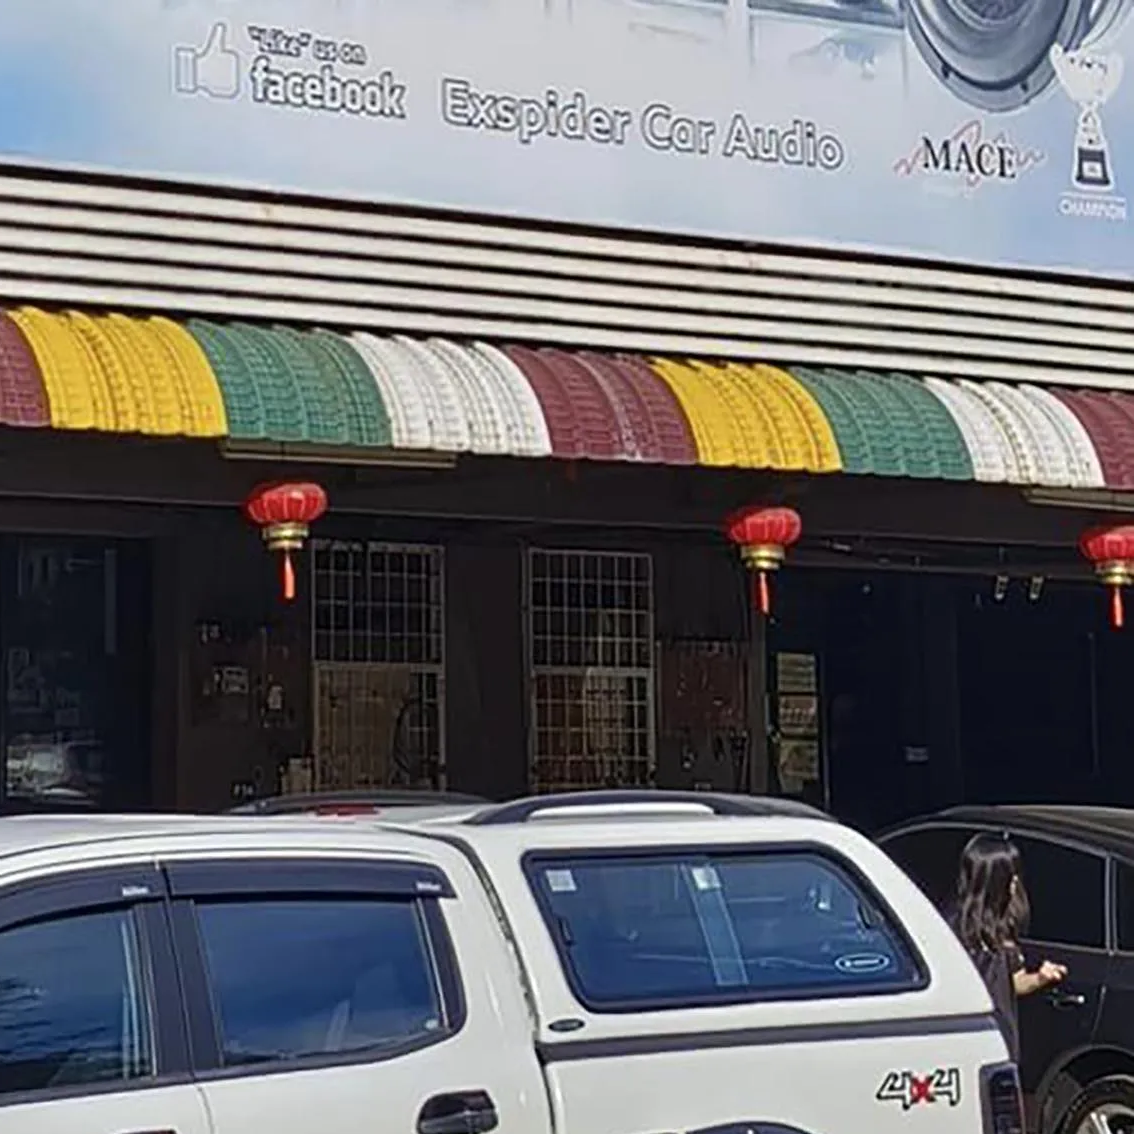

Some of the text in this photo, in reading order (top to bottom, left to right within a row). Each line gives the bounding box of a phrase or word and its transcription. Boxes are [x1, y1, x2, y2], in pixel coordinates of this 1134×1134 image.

[251, 55, 406, 119] facebook
[442, 79, 844, 170] Exspider Car Audio
[922, 136, 1016, 178] MACE
